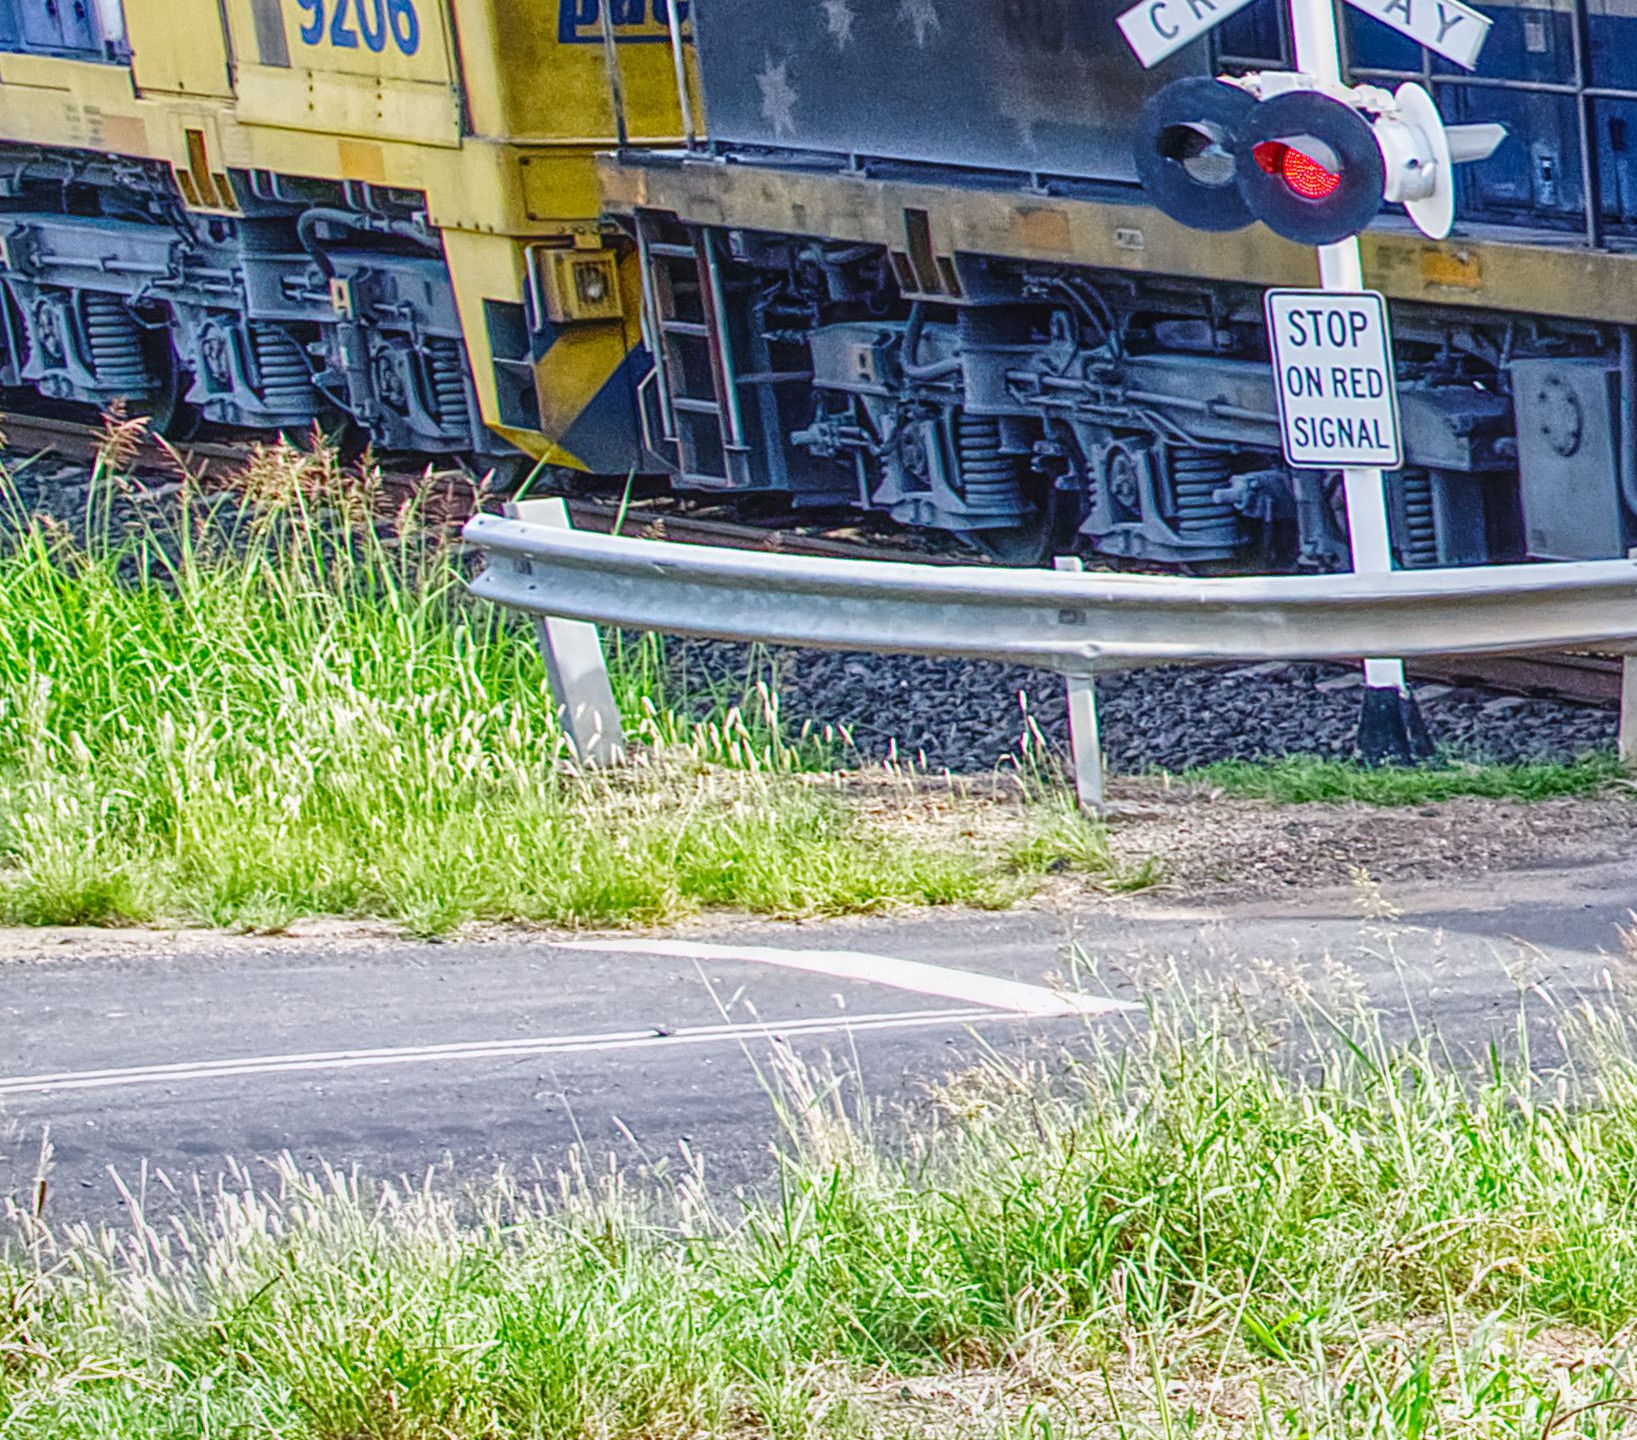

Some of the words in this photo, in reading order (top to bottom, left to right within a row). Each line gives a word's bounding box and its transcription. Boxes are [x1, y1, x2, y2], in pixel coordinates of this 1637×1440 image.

[1287, 309, 1368, 347] STOP
[1287, 365, 1324, 398] ON
[1332, 367, 1384, 400] RED
[1293, 417, 1391, 450] SIGNAL
